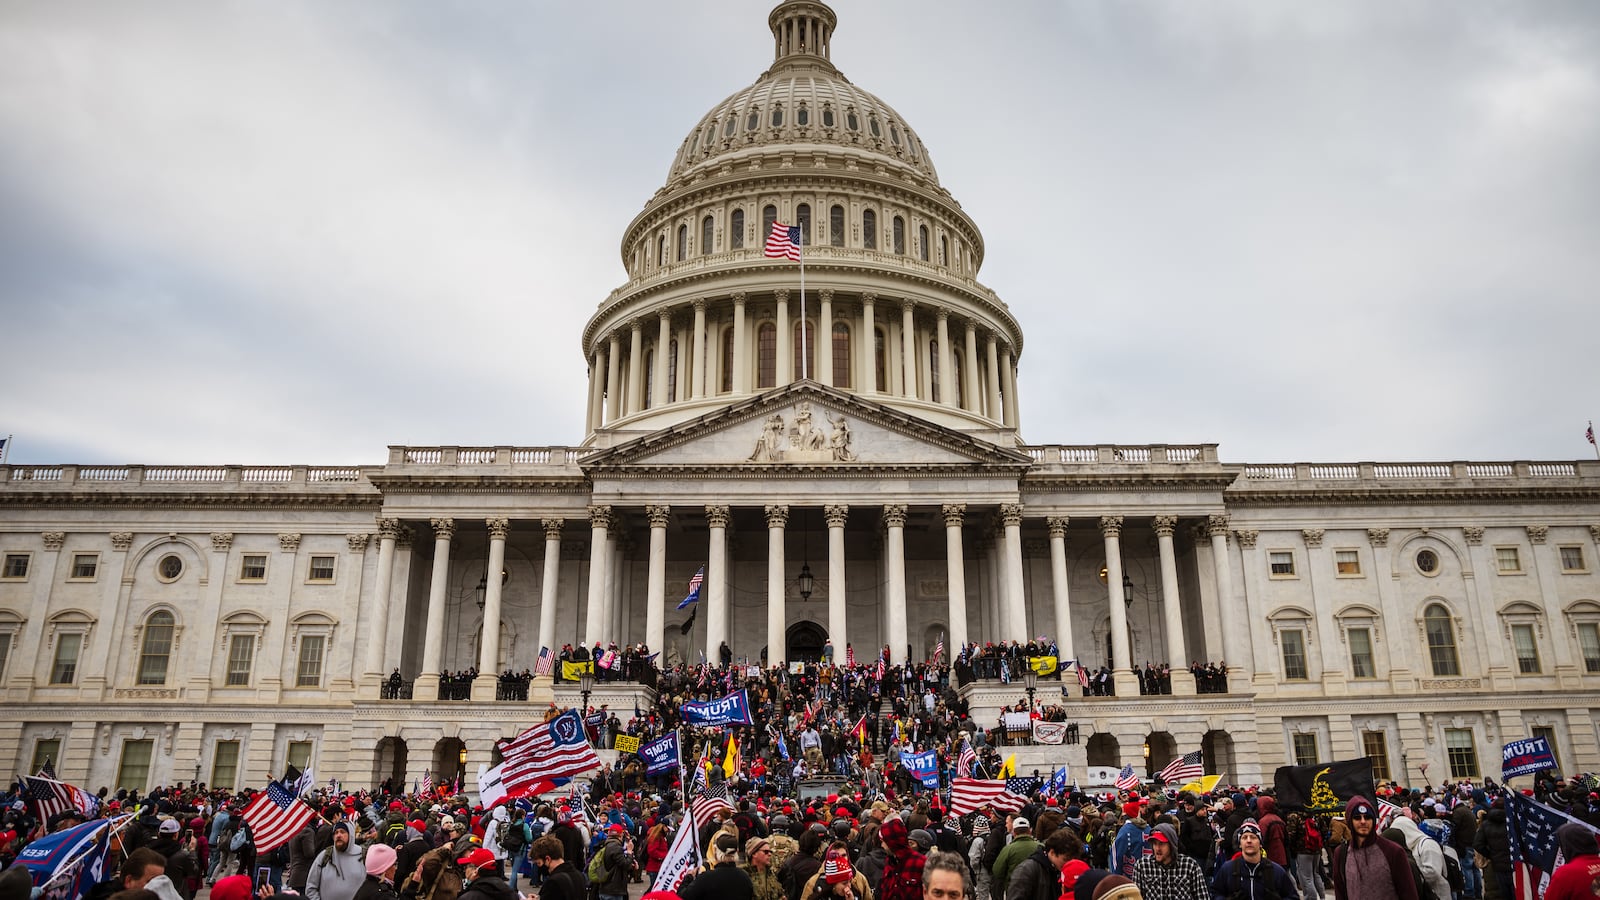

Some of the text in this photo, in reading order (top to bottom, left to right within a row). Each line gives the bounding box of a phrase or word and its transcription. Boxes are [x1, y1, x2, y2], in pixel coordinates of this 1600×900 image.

[618, 735, 639, 745] JESUS
[615, 742, 637, 752] SAVES
[662, 870, 676, 891] MILY
